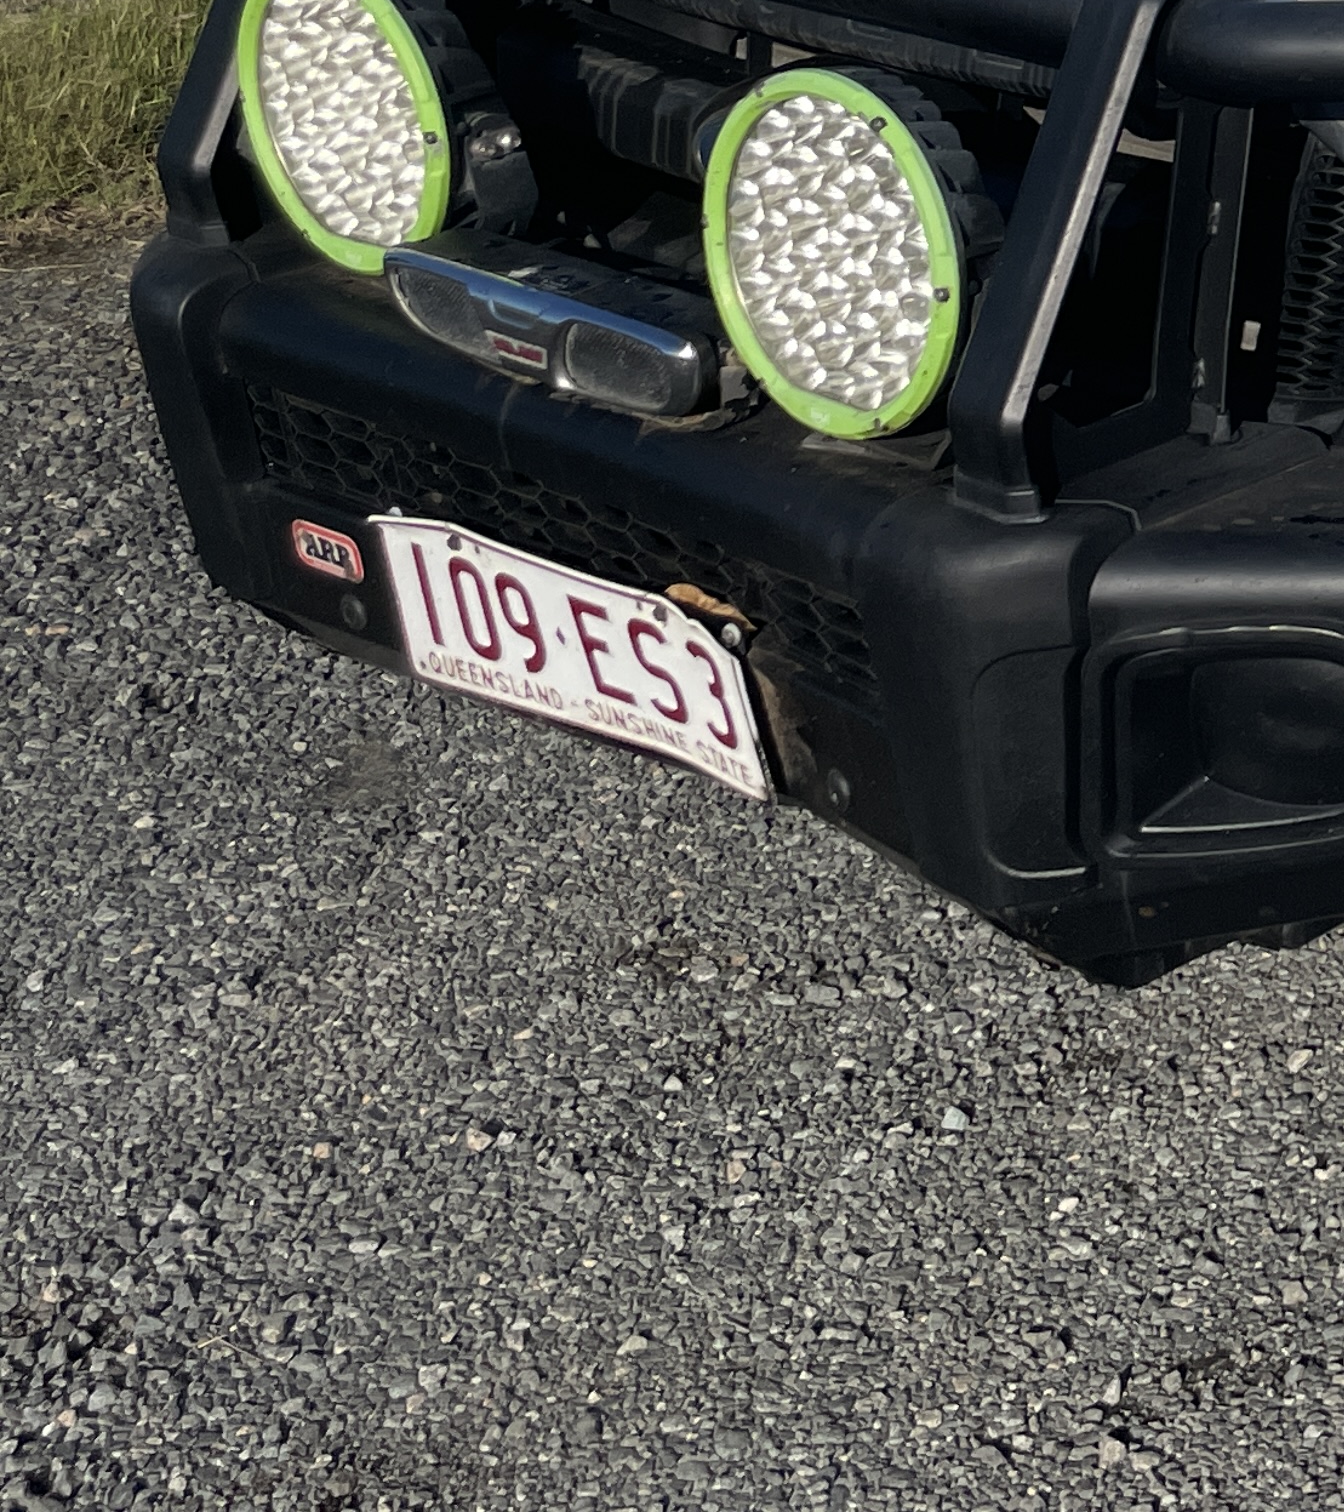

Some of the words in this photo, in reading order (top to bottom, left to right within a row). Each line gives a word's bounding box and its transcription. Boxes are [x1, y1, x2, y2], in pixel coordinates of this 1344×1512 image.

[427, 650, 564, 710] QUEENSLAND
[584, 698, 689, 754] SUNSHINE
[696, 740, 756, 782] STATE
